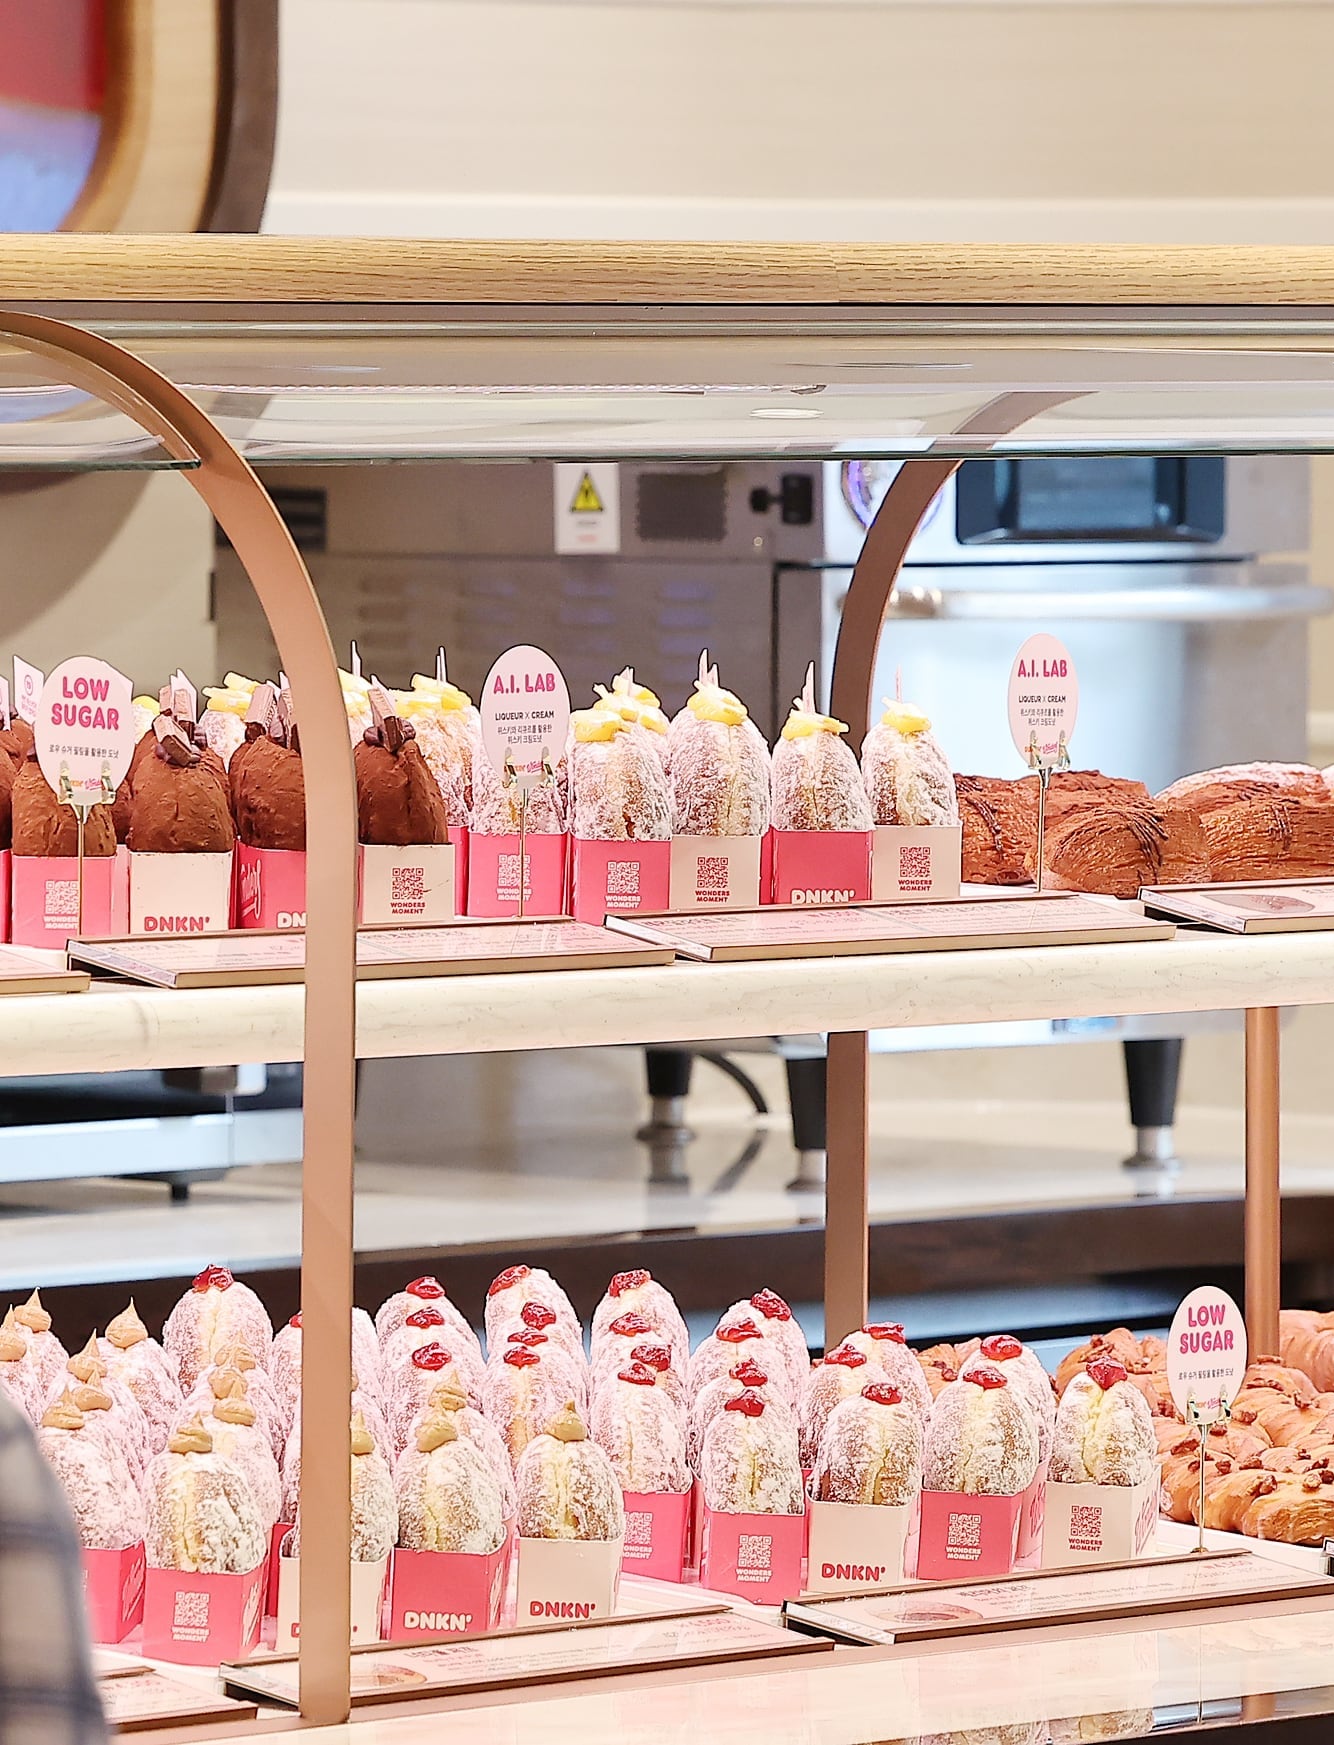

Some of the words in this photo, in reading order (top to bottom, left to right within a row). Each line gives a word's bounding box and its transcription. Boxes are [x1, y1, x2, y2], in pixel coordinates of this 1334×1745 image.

[1017, 659, 1039, 678] A.I.
[1043, 659, 1067, 678] LAB
[63, 676, 110, 702] LOW
[493, 675, 520, 694] A.I.
[525, 673, 556, 692] LAB
[1047, 695, 1067, 703] CREAM
[51, 703, 119, 730] SUGAR
[495, 712, 523, 721] LIQUEUR
[531, 710, 555, 719] CREAM
[606, 901, 640, 909] MOMENT
[143, 916, 210, 932] DNKN'
[1188, 1304, 1225, 1327] LOW
[1179, 1329, 1234, 1354] SUGAR
[1068, 1538, 1103, 1546] WONDERS
[623, 1545, 652, 1553] ONDERS
[945, 1546, 982, 1554] WONDERS
[1069, 1544, 1101, 1552] MOMENT
[946, 1553, 979, 1561] MOMENT
[736, 1568, 772, 1576] WONDERS
[821, 1563, 886, 1581] DNKN'
[530, 1601, 596, 1618] DNKN'
[403, 1610, 473, 1631] DNKN'
[172, 1626, 209, 1636] WONDERS
[173, 1634, 207, 1643] MOMENT
